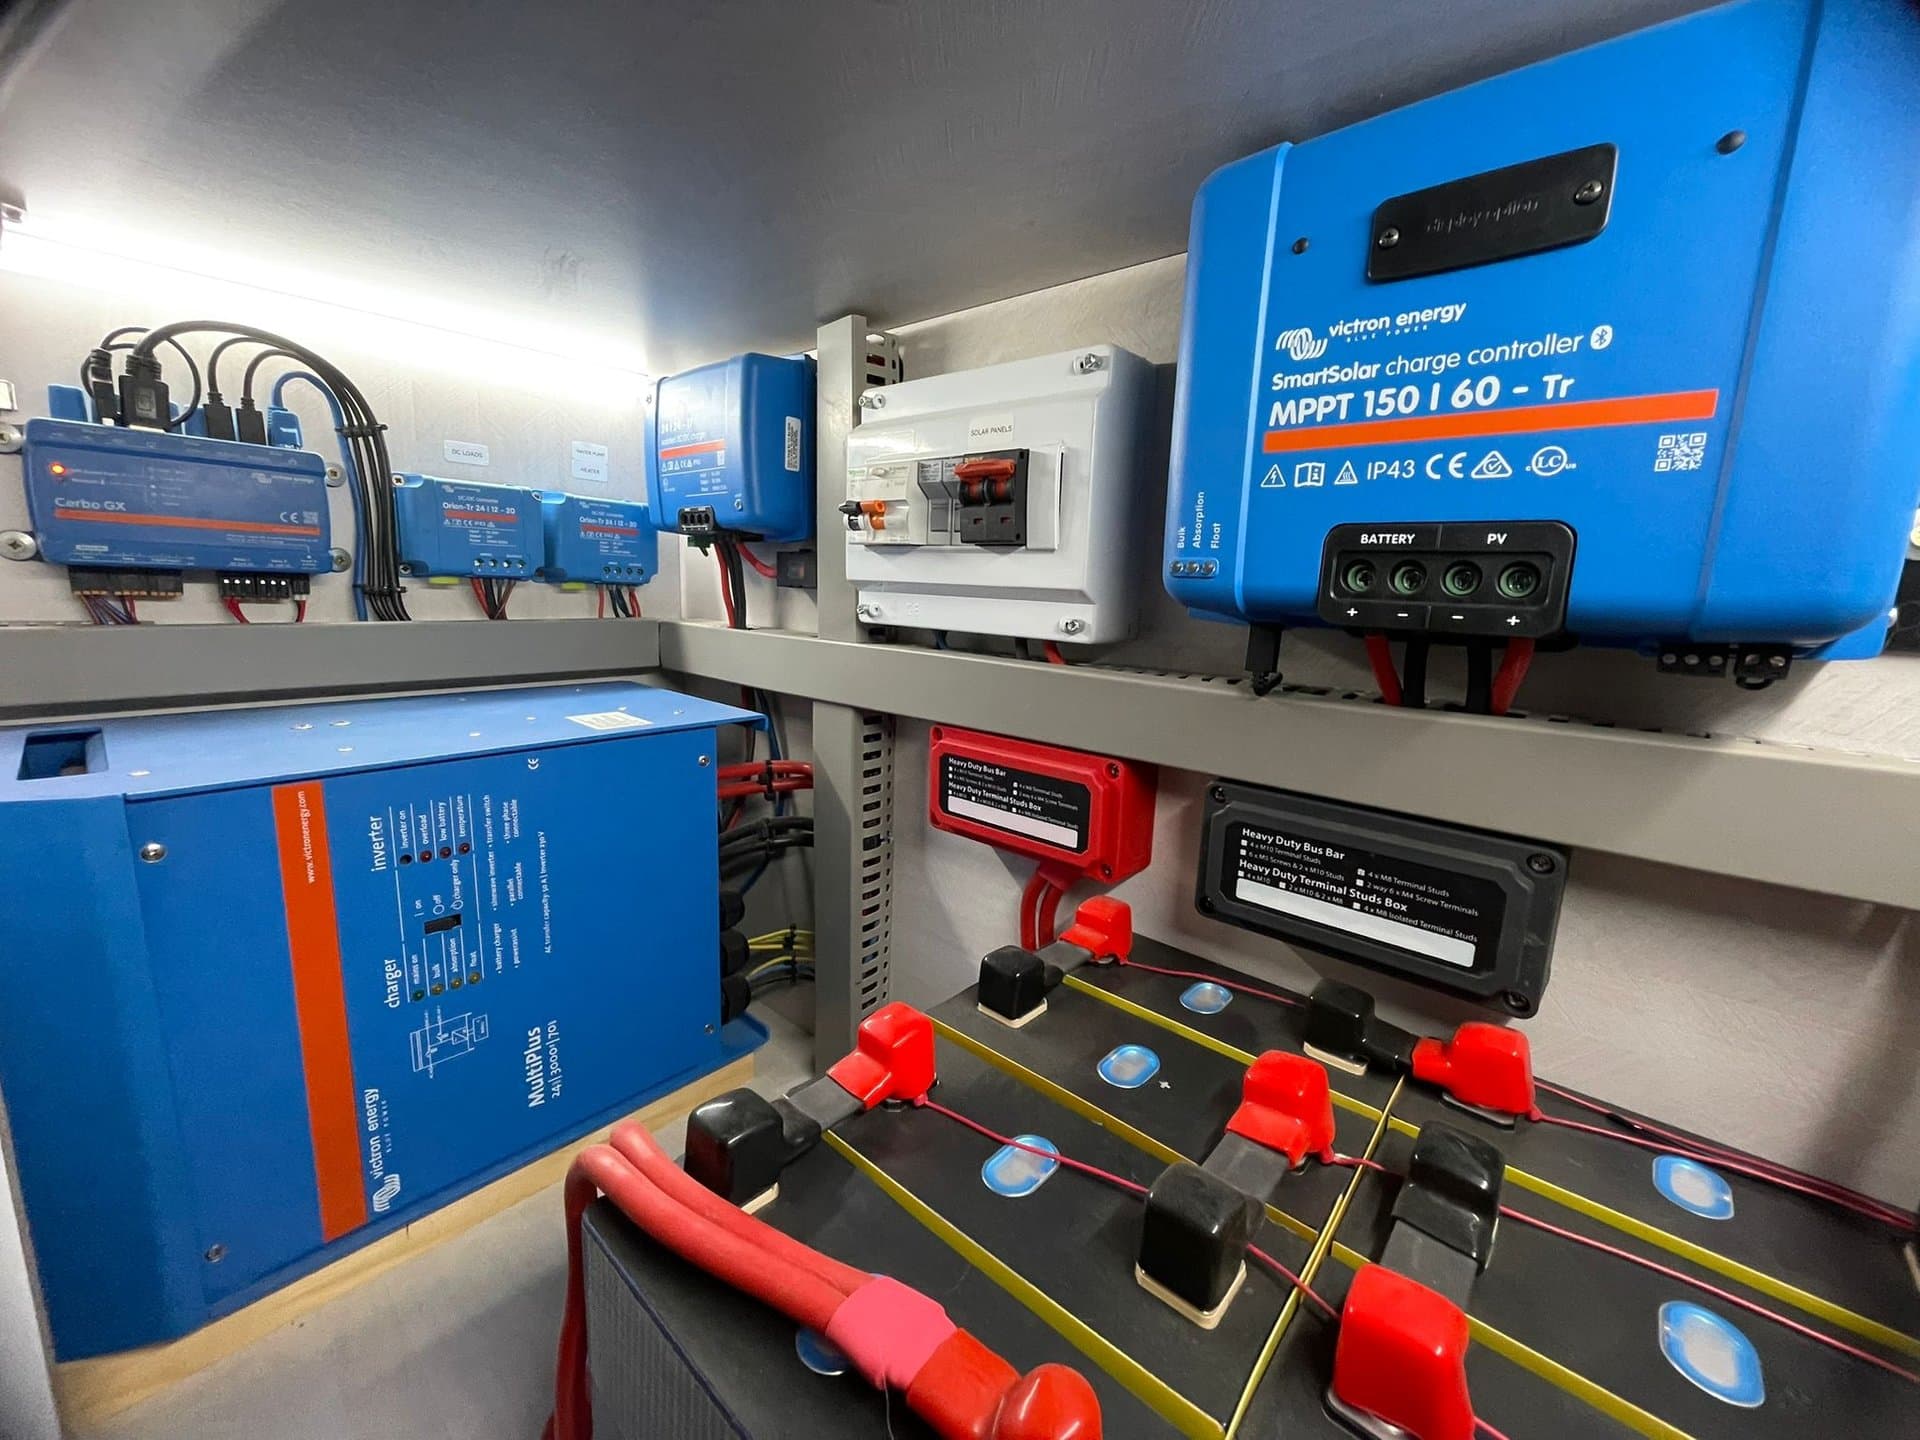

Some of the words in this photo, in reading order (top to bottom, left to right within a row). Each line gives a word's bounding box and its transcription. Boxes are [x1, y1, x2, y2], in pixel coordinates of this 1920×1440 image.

[1328, 315, 1391, 337] victron
[1395, 302, 1467, 326] energy
[1346, 333, 1376, 343] BLUE
[1386, 325, 1428, 338] POWER
[1271, 361, 1381, 391] SmartSolar
[1385, 354, 1461, 375] charge
[1467, 332, 1584, 366] controller
[1268, 392, 1355, 427] MPPT
[1363, 384, 1420, 418] 150
[1450, 375, 1501, 409] 60
[1541, 373, 1576, 400] Tr
[970, 427, 989, 437] SOLAR
[990, 424, 1012, 435] PANELS
[1366, 459, 1416, 481] IP43
[103, 500, 127, 512] GX
[442, 502, 474, 511] Orion-Tr
[475, 504, 486, 512] 24
[505, 507, 516, 515] 20
[1192, 491, 1205, 549] Absorption
[1176, 526, 1186, 549] Bulk
[1210, 522, 1221, 549] Float
[1360, 533, 1416, 545] BATTERY
[1486, 532, 1508, 545] PV
[948, 757, 967, 769] Heavy
[968, 762, 982, 773] Duty
[983, 765, 995, 775] Bus
[995, 768, 1007, 777] Bar
[483, 794, 491, 816] switch
[948, 781, 967, 794] Heavy
[967, 786, 982, 797] Duty
[982, 789, 1009, 803] Terminal
[1009, 796, 1028, 809] Studs
[1028, 801, 1042, 812] Box
[400, 810, 406, 820] on
[438, 802, 447, 828] battery
[457, 795, 466, 838] temperature
[297, 790, 316, 885] www.victronenergy.com
[418, 814, 429, 845] overload
[440, 828, 448, 841] low
[484, 817, 493, 844] transfer
[368, 816, 387, 872] inverter
[1242, 827, 1275, 844] Heavy
[1275, 835, 1301, 851] Duty
[1303, 842, 1323, 855] Bus
[1325, 848, 1346, 860] Bar
[1260, 844, 1274, 853] M10
[1275, 848, 1302, 860] Terminal
[1302, 854, 1321, 865] Studs
[450, 859, 460, 874] only
[1270, 855, 1292, 868] Screws
[1310, 866, 1325, 876] M10
[1325, 869, 1345, 881] Studs
[452, 875, 462, 899] charger
[1239, 858, 1271, 876] Heavy
[1272, 867, 1298, 883] Duty
[1299, 874, 1347, 895] Terminal
[1349, 888, 1382, 905] Studs
[1384, 898, 1408, 912] Box
[1380, 874, 1392, 882] M8
[1393, 877, 1426, 891] Terminal
[1427, 886, 1450, 897] Studs
[415, 899, 422, 909] on
[432, 894, 441, 905] off
[1373, 884, 1389, 893] way
[1401, 891, 1414, 899] M4
[1416, 894, 1439, 906] Screw
[1440, 900, 1479, 917] Terminals
[493, 923, 502, 946] charger
[1376, 908, 1388, 918] M8
[1389, 912, 1419, 926] Isolated
[1420, 920, 1454, 936] Terminal
[1455, 930, 1478, 943] Studs
[411, 953, 418, 964] on
[449, 937, 459, 973] absorption
[469, 951, 477, 968] float
[495, 947, 503, 971] battery
[411, 963, 420, 985] mains
[431, 963, 441, 979] bulk
[383, 959, 402, 1008] charger
[523, 1026, 546, 1108] MultiPlus
[364, 1088, 379, 1132] energy
[369, 1135, 384, 1180] victron
